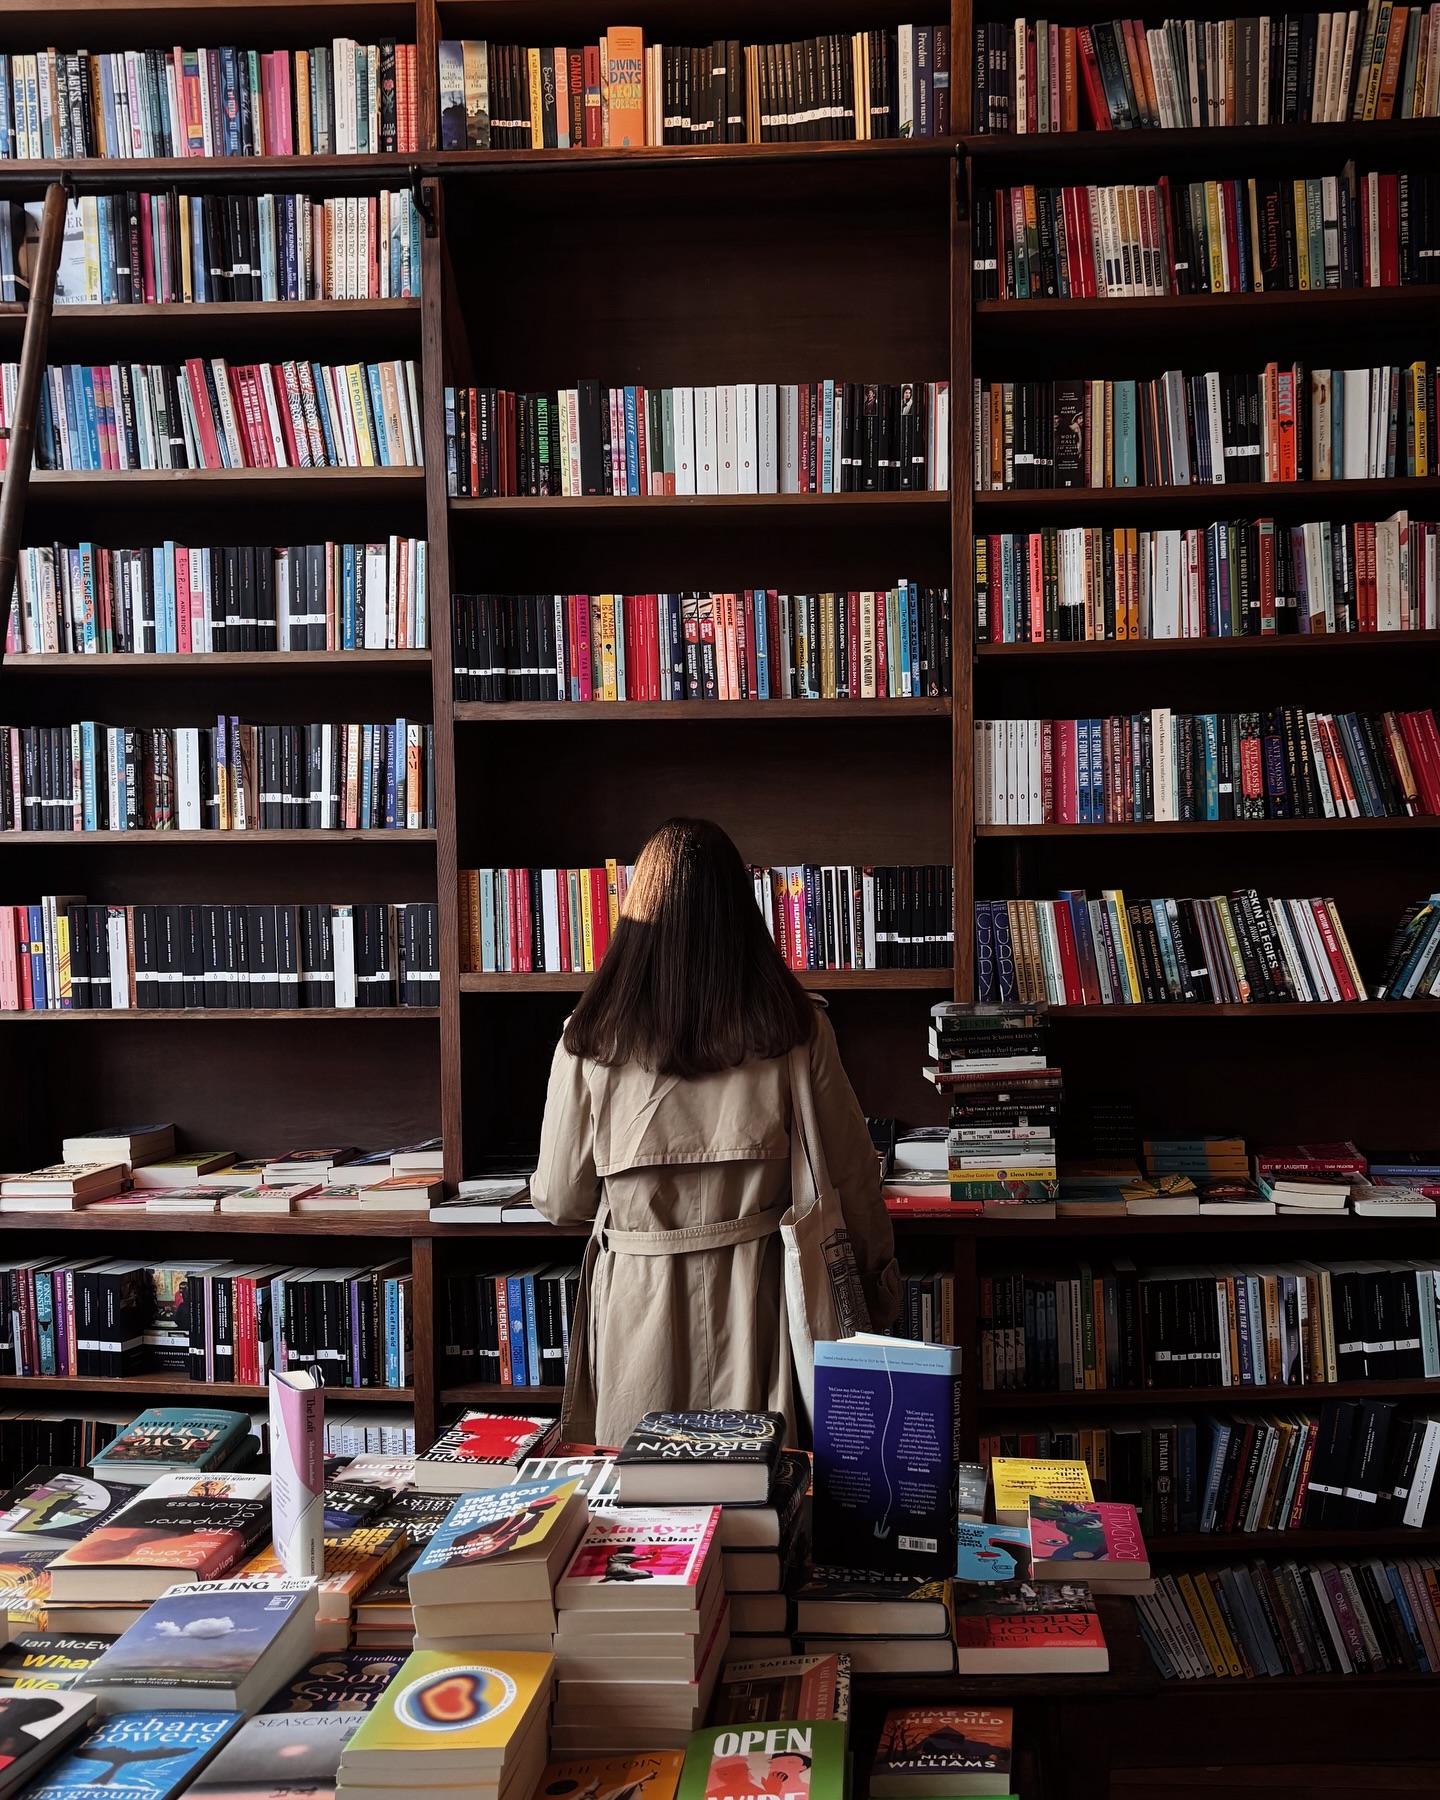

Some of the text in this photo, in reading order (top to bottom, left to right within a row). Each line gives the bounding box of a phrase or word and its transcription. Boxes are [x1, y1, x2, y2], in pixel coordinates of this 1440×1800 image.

[977, 29, 985, 53] PRIZE
[918, 33, 927, 67] Freedom
[609, 59, 642, 84] DIVINE DAYS
[57, 76, 67, 126] The Leviathan
[66, 57, 83, 153] THE ABYSS LEONID ANDREYEV
[570, 55, 582, 139] CANADA RICHARD FORD
[27, 79, 38, 134] DJINN PATROL
[1400, 175, 1409, 245] BLACK MAD WHEEL
[1091, 213, 1099, 234] LUTZ
[1265, 192, 1278, 268] Tenderness
[133, 278, 140, 288] UP
[326, 260, 334, 292] BARKER
[299, 365, 316, 430] HOPE GLORY
[1279, 376, 1292, 416] BECKY
[224, 410, 232, 427] MAID
[537, 398, 550, 463] UNSETTLED GROUND
[1368, 551, 1376, 579] MONSTERS
[82, 556, 92, 604] BLUE SKIES
[1043, 724, 1051, 734] THE
[1044, 751, 1052, 773] MOTHER
[1093, 726, 1102, 786] THE FORTUNE MEN
[126, 764, 134, 785] KEEPING
[1250, 740, 1259, 794] KATE MOSSE
[793, 904, 801, 928] SILENCE
[1248, 890, 1278, 968] SKIN ELEGIES
[1142, 905, 1162, 979] LOCKS ASHLEIGH NUGENT
[1172, 920, 1185, 964] MISS EMILY
[36, 1281, 44, 1317] MONSTER
[499, 1308, 507, 1340] MERCIES
[306, 1396, 315, 1433] The Loft
[953, 1380, 962, 1461] Colum McCann
[1256, 1429, 1264, 1439] go
[133, 1437, 199, 1450] love
[636, 1442, 762, 1451] BROWN
[1255, 1442, 1262, 1451] as
[418, 1453, 502, 1464] HERSCHT
[1160, 1443, 1168, 1471] ITALIAN
[1249, 1456, 1258, 1475] river
[464, 1486, 550, 1504] THE MOST
[166, 1501, 264, 1510] Gladness
[453, 1501, 536, 1521] MEMORY
[460, 1497, 519, 1512] SECRET
[144, 1517, 245, 1527] Emperor
[224, 1510, 255, 1519] of
[449, 1511, 518, 1526] OF MEN
[194, 1527, 234, 1536] The
[349, 1528, 394, 1538] BIG
[592, 1524, 702, 1536] Martyr!
[1108, 1510, 1140, 1560] ROADKILL
[324, 1536, 386, 1546] GREW
[584, 1536, 639, 1545] Kaveh
[125, 1557, 199, 1565] Ocean
[136, 1548, 206, 1558] Vuong
[422, 1555, 452, 1565] Sarr
[169, 1581, 270, 1595] ENDLING
[966, 1615, 1090, 1625] Friends
[1335, 1592, 1360, 1646] ONE DAY
[21, 1639, 112, 1650] Ian McEw
[22, 1654, 100, 1669] What
[732, 1657, 819, 1672] THE SAFEKEEP
[13, 1678, 60, 1690] We
[318, 1670, 390, 1683] Son
[303, 1688, 385, 1702] Sun
[94, 1719, 229, 1733] richard
[257, 1717, 365, 1728] SEASCRAPE
[940, 1717, 1004, 1725] CHILD
[80, 1732, 215, 1748] powers
[714, 1727, 812, 1757] OPEN
[606, 1758, 662, 1771] COIN
[888, 1760, 996, 1768] WILLIAMS
